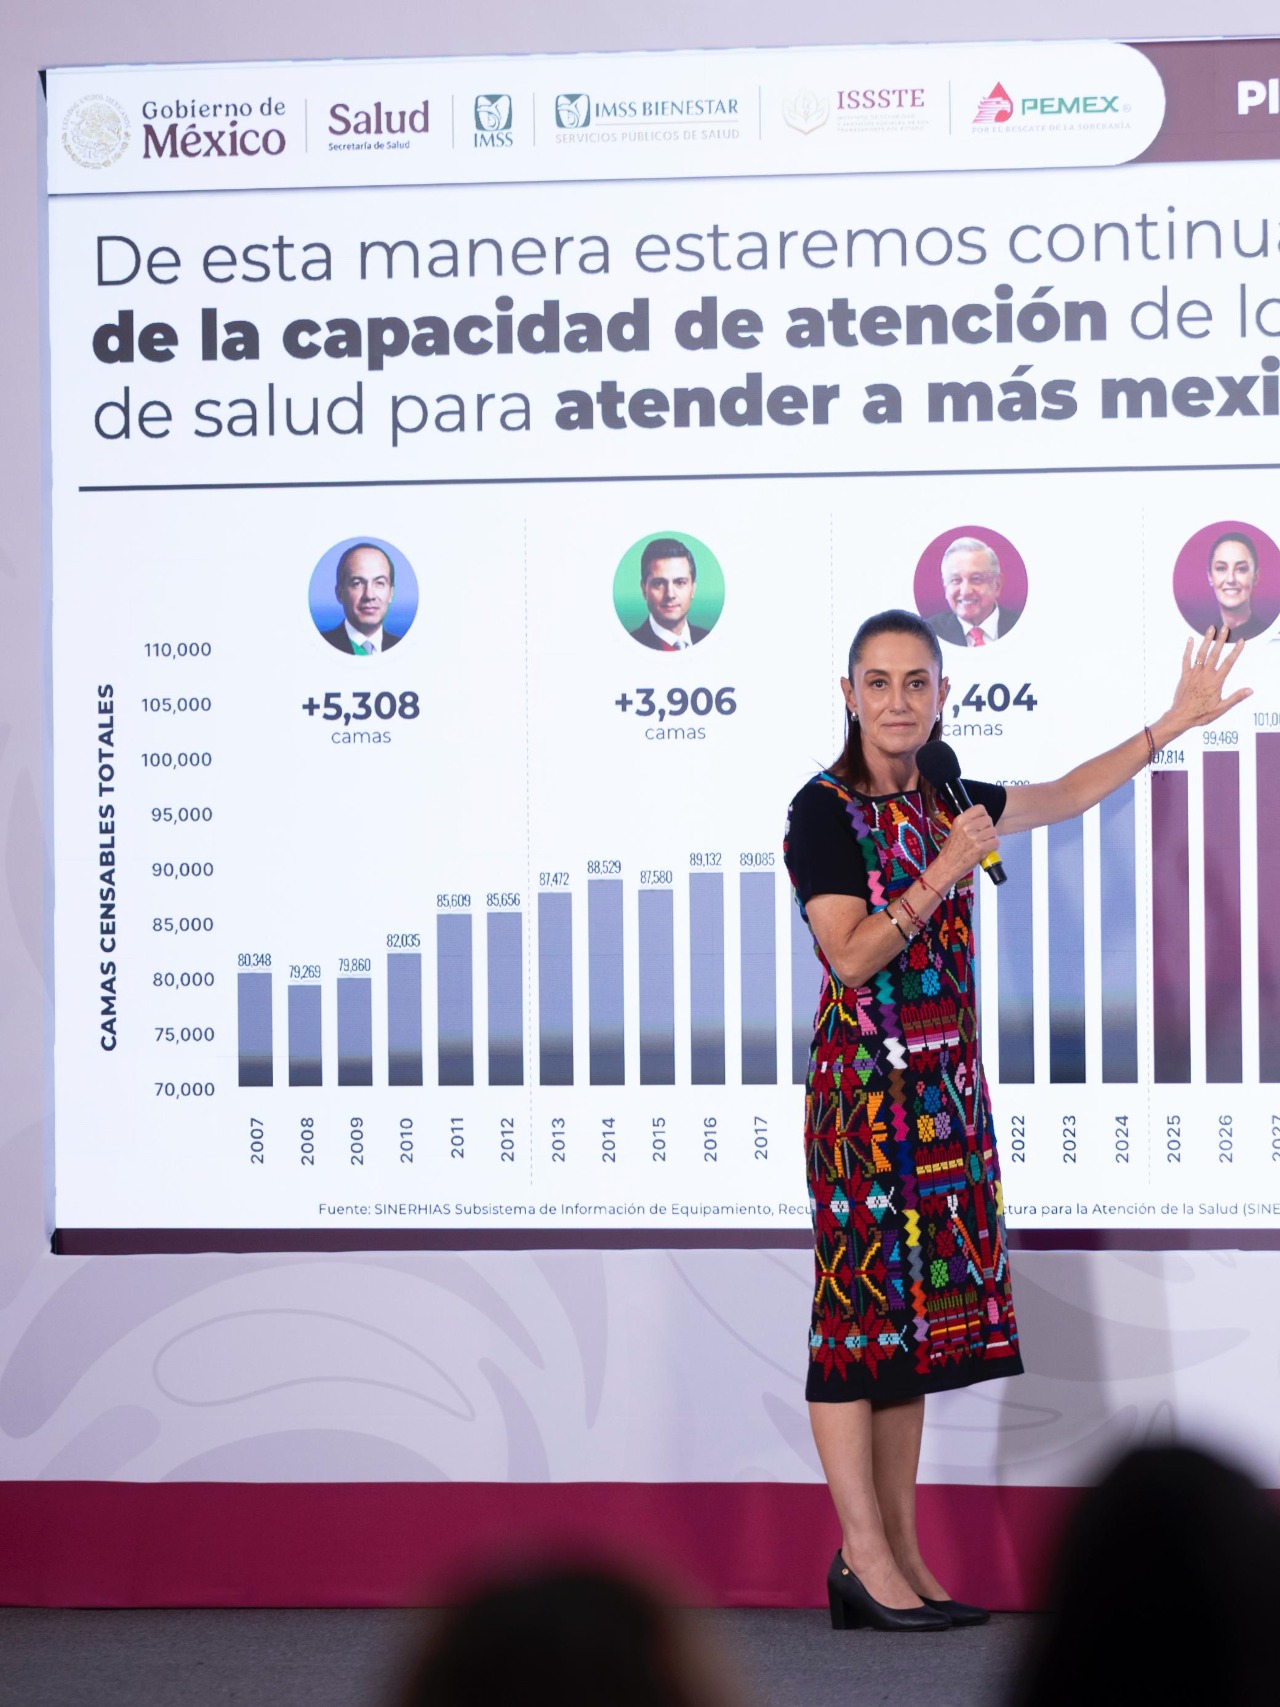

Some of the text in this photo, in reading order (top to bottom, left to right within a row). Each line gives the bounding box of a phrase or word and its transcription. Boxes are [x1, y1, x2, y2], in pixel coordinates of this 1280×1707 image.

[143, 99, 252, 119] Gobierno
[260, 97, 285, 116] de
[596, 99, 737, 117] IMSS BIENESTAR
[838, 89, 924, 109] ISSSTE
[1022, 96, 1119, 115] PEMEX
[329, 100, 429, 135] Salud
[143, 120, 285, 159] México
[475, 132, 513, 147] IMSS
[556, 129, 739, 144] SERVICIOS PÚBLICOS DE SALUD
[329, 141, 409, 151] Secretaría de Salud
[97, 236, 181, 286] De
[203, 235, 331, 283] esta
[360, 236, 609, 280] manera
[636, 225, 986, 273] estaremos
[92, 310, 178, 364] de
[202, 308, 259, 361] la
[283, 295, 649, 371] capacidad
[675, 296, 763, 351] de
[786, 284, 1106, 348] atención
[1131, 285, 1212, 340] de
[95, 386, 172, 439] de
[194, 381, 363, 438] salud
[392, 393, 530, 447] para
[555, 372, 839, 430] atender
[863, 383, 902, 424] a
[928, 365, 1077, 422] más
[145, 642, 211, 659] 110,000
[142, 698, 211, 714] 105,000
[302, 691, 419, 726] +5,308
[615, 687, 736, 722] +3,906
[946, 682, 1038, 718] ,404
[331, 732, 391, 744] camas
[645, 728, 705, 740] camas
[942, 723, 1003, 736] camas
[1203, 731, 1238, 744] 99,469
[142, 752, 212, 769] 100,000
[152, 807, 212, 825] 95,000
[98, 684, 116, 1051] CAMAS CENSABLES TOTALES
[588, 860, 621, 873] 88,529
[690, 853, 721, 866] 89,132
[740, 853, 775, 867] 89,085
[152, 863, 213, 879] 90,000
[540, 872, 569, 886] 87,472
[641, 871, 672, 884] 87,580
[437, 894, 471, 908] 85,609
[487, 893, 520, 906] 85,656
[153, 918, 213, 934] 85,000
[387, 934, 420, 948] 82,035
[238, 953, 271, 966] 80,348
[339, 958, 370, 972] 79,860
[153, 972, 214, 989] 80,000
[290, 965, 321, 980] 79,269
[155, 1027, 214, 1044] 75,000
[155, 1083, 214, 1099] 70,000
[251, 1118, 263, 1164] 2007
[301, 1118, 314, 1165] 2008
[351, 1118, 363, 1165] 2009
[400, 1118, 413, 1163] 2010
[451, 1118, 464, 1158] 2011
[501, 1118, 514, 1161] 2012
[552, 1118, 565, 1162] 2013
[602, 1118, 615, 1162] 2014
[653, 1118, 665, 1161] 2015
[704, 1118, 717, 1162] 2016
[754, 1116, 768, 1159] 2017
[1012, 1116, 1025, 1162] 2022
[1063, 1116, 1076, 1163] 2023
[1115, 1115, 1129, 1163] 2024
[1167, 1116, 1181, 1163] 2025
[1219, 1115, 1232, 1163] 2026
[319, 1204, 371, 1214] Fuente:
[375, 1204, 450, 1214] SINERHIAS
[456, 1204, 535, 1214] Subsistema
[540, 1204, 556, 1214] de
[562, 1203, 644, 1214] Información
[650, 1204, 666, 1214] de
[672, 1204, 774, 1217] Equipamiento,
[1042, 1206, 1071, 1216] para
[1077, 1203, 1087, 1214] la
[1092, 1204, 1155, 1214] Atención
[1161, 1203, 1178, 1214] de
[1183, 1203, 1193, 1214] la
[1199, 1203, 1237, 1214] Salud
